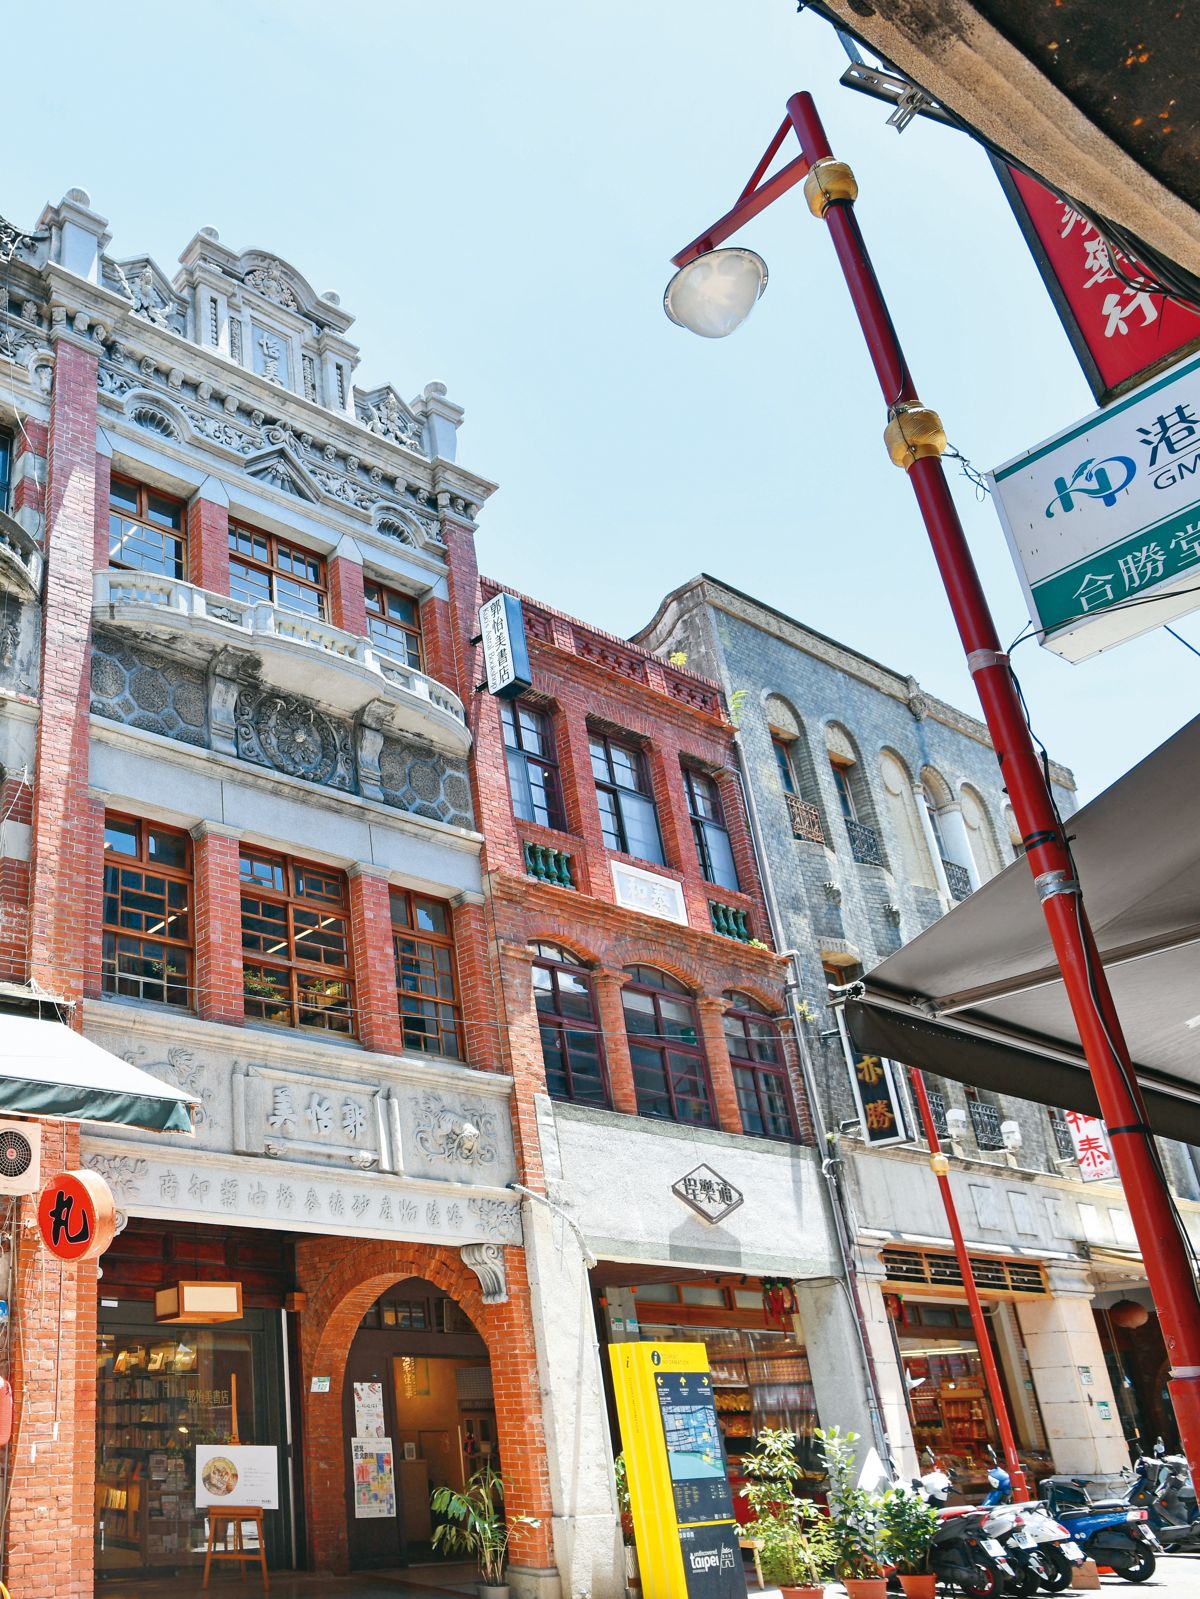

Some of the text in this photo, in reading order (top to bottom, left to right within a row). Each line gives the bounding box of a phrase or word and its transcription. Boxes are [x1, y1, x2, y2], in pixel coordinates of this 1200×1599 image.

[490, 599, 510, 685] 郭怡美書店
[48, 1190, 90, 1246] 丸
[690, 1552, 720, 1572] taipei
